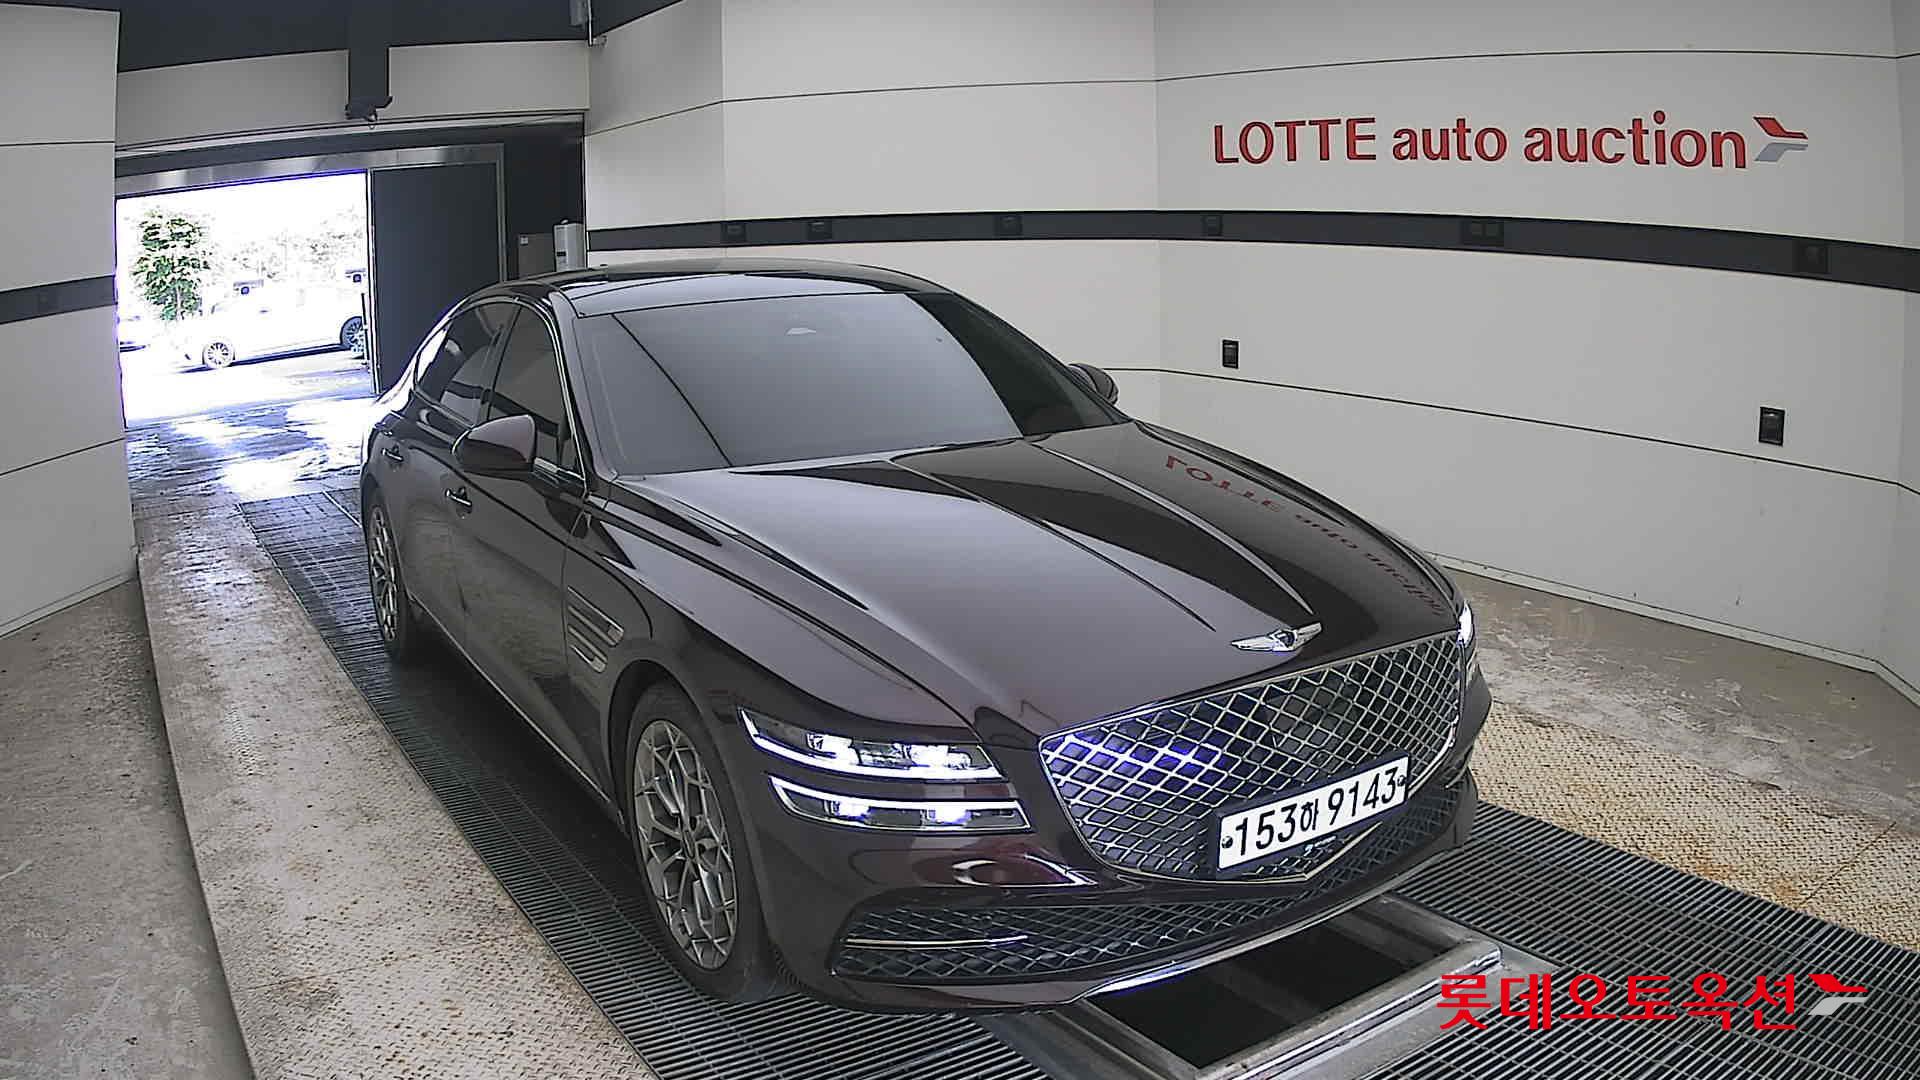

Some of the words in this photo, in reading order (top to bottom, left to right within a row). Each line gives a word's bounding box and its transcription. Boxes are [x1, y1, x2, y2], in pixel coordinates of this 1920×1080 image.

[1214, 117, 1376, 163] LOTTE
[1393, 118, 1508, 161] auto
[1524, 111, 1747, 169] auction
[1235, 798, 1320, 856] 153하
[1327, 766, 1399, 826] 9143
